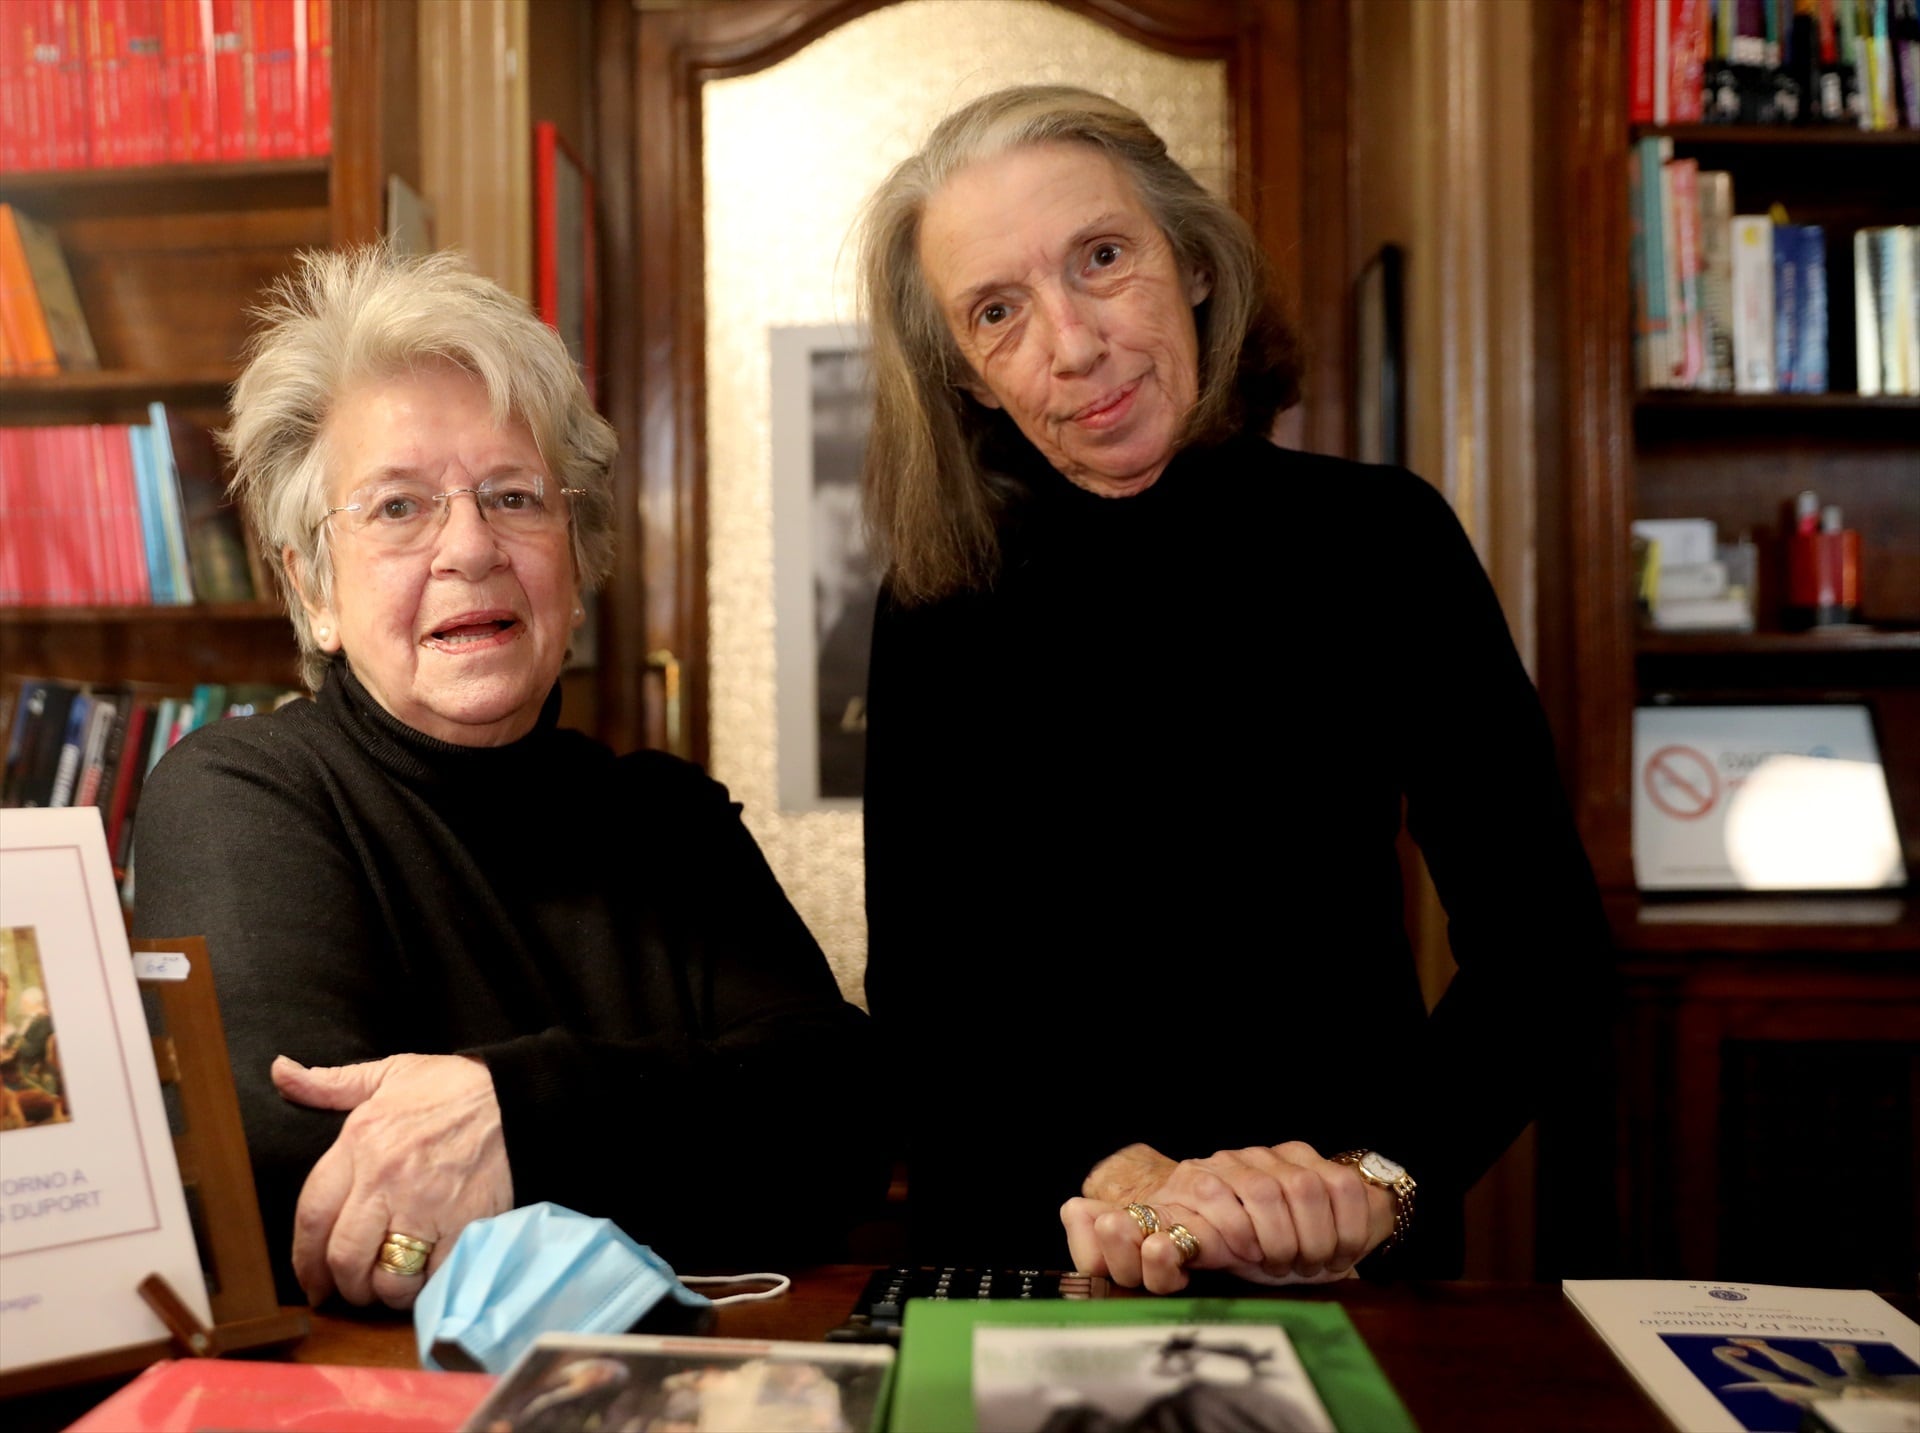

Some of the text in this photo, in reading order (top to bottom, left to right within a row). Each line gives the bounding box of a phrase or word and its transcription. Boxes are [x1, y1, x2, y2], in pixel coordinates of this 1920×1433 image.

[0, 1168, 88, 1196] ORNO A
[10, 1189, 102, 1221] DUPORT
